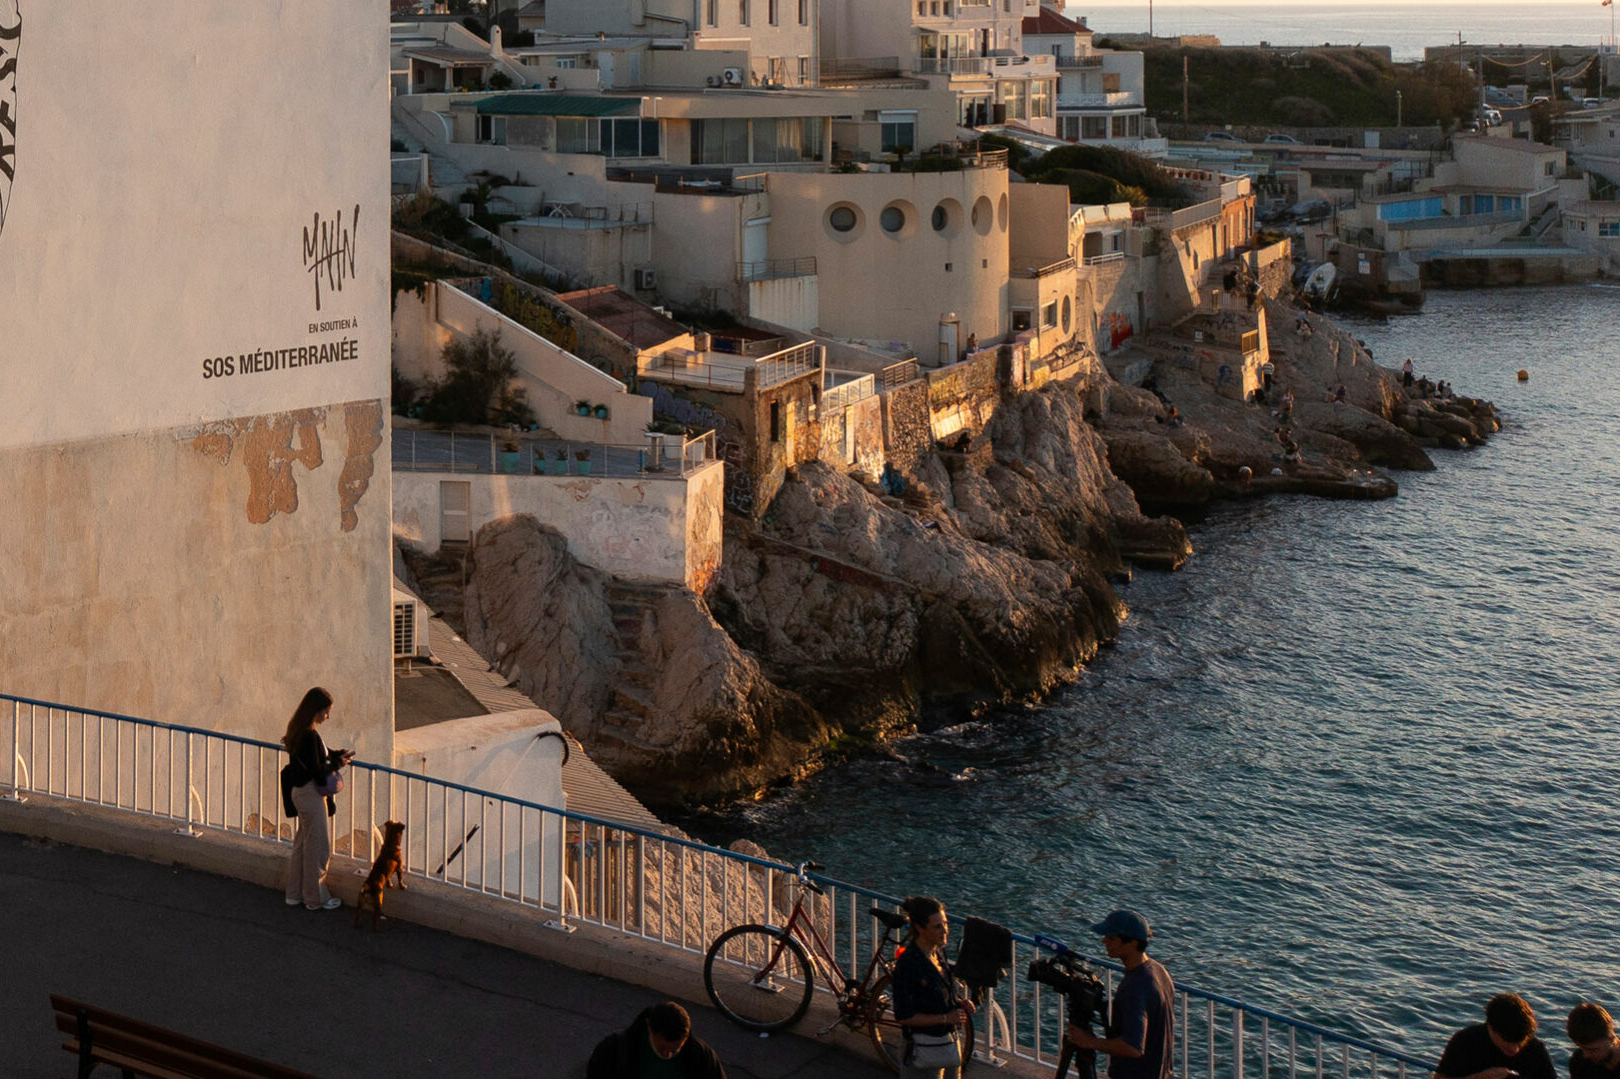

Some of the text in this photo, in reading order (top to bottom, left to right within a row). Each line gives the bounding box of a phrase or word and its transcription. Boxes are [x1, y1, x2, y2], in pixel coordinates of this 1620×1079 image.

[308, 323, 319, 334] EN
[320, 319, 351, 332] SOUTIEN
[202, 337, 358, 379] SOS MÉDITERRANÉE
